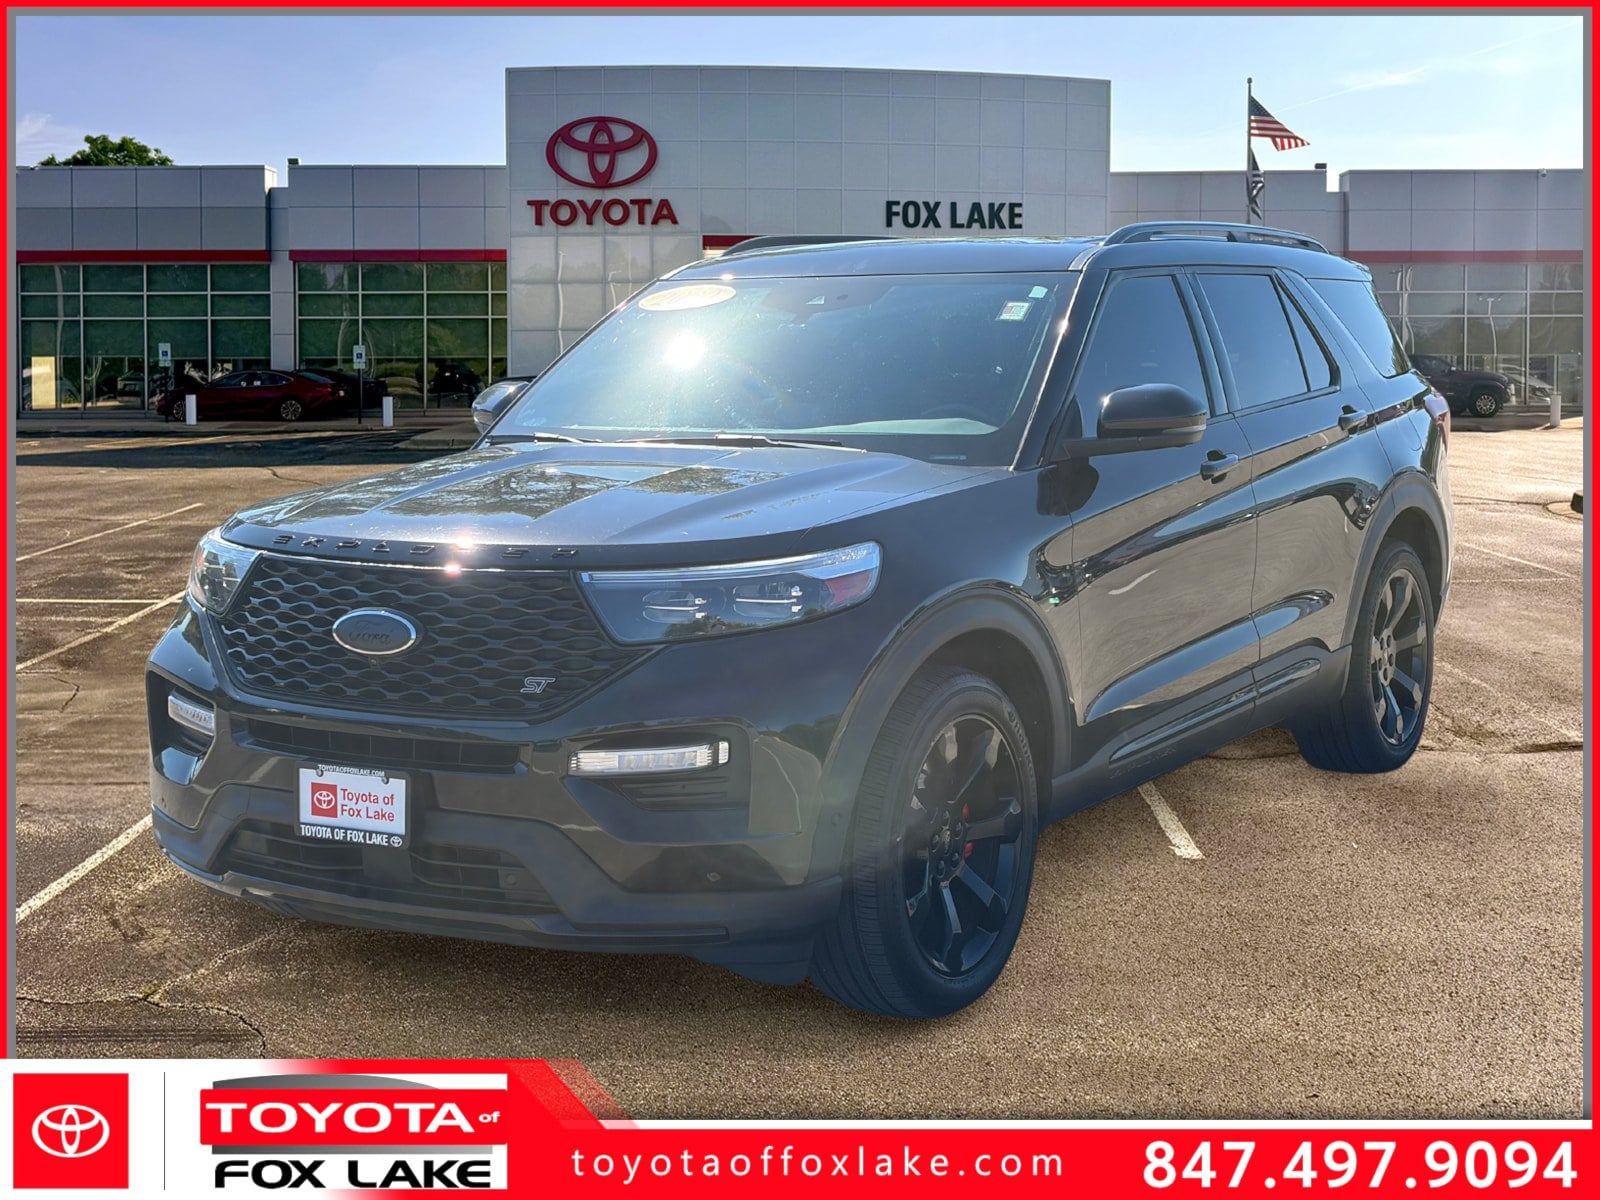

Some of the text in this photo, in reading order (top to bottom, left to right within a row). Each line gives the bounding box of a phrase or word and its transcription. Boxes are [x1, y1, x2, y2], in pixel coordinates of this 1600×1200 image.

[527, 198, 679, 227] TOYOTA
[884, 200, 1023, 230] FOX LAKE
[520, 676, 556, 694] ST
[318, 764, 385, 777] TOYOTAOFFOXLAKE.COM
[341, 788, 395, 806] Toyota of
[340, 804, 395, 822] Fox Lake
[300, 824, 389, 846] TOYOTA OF FOX LAKE
